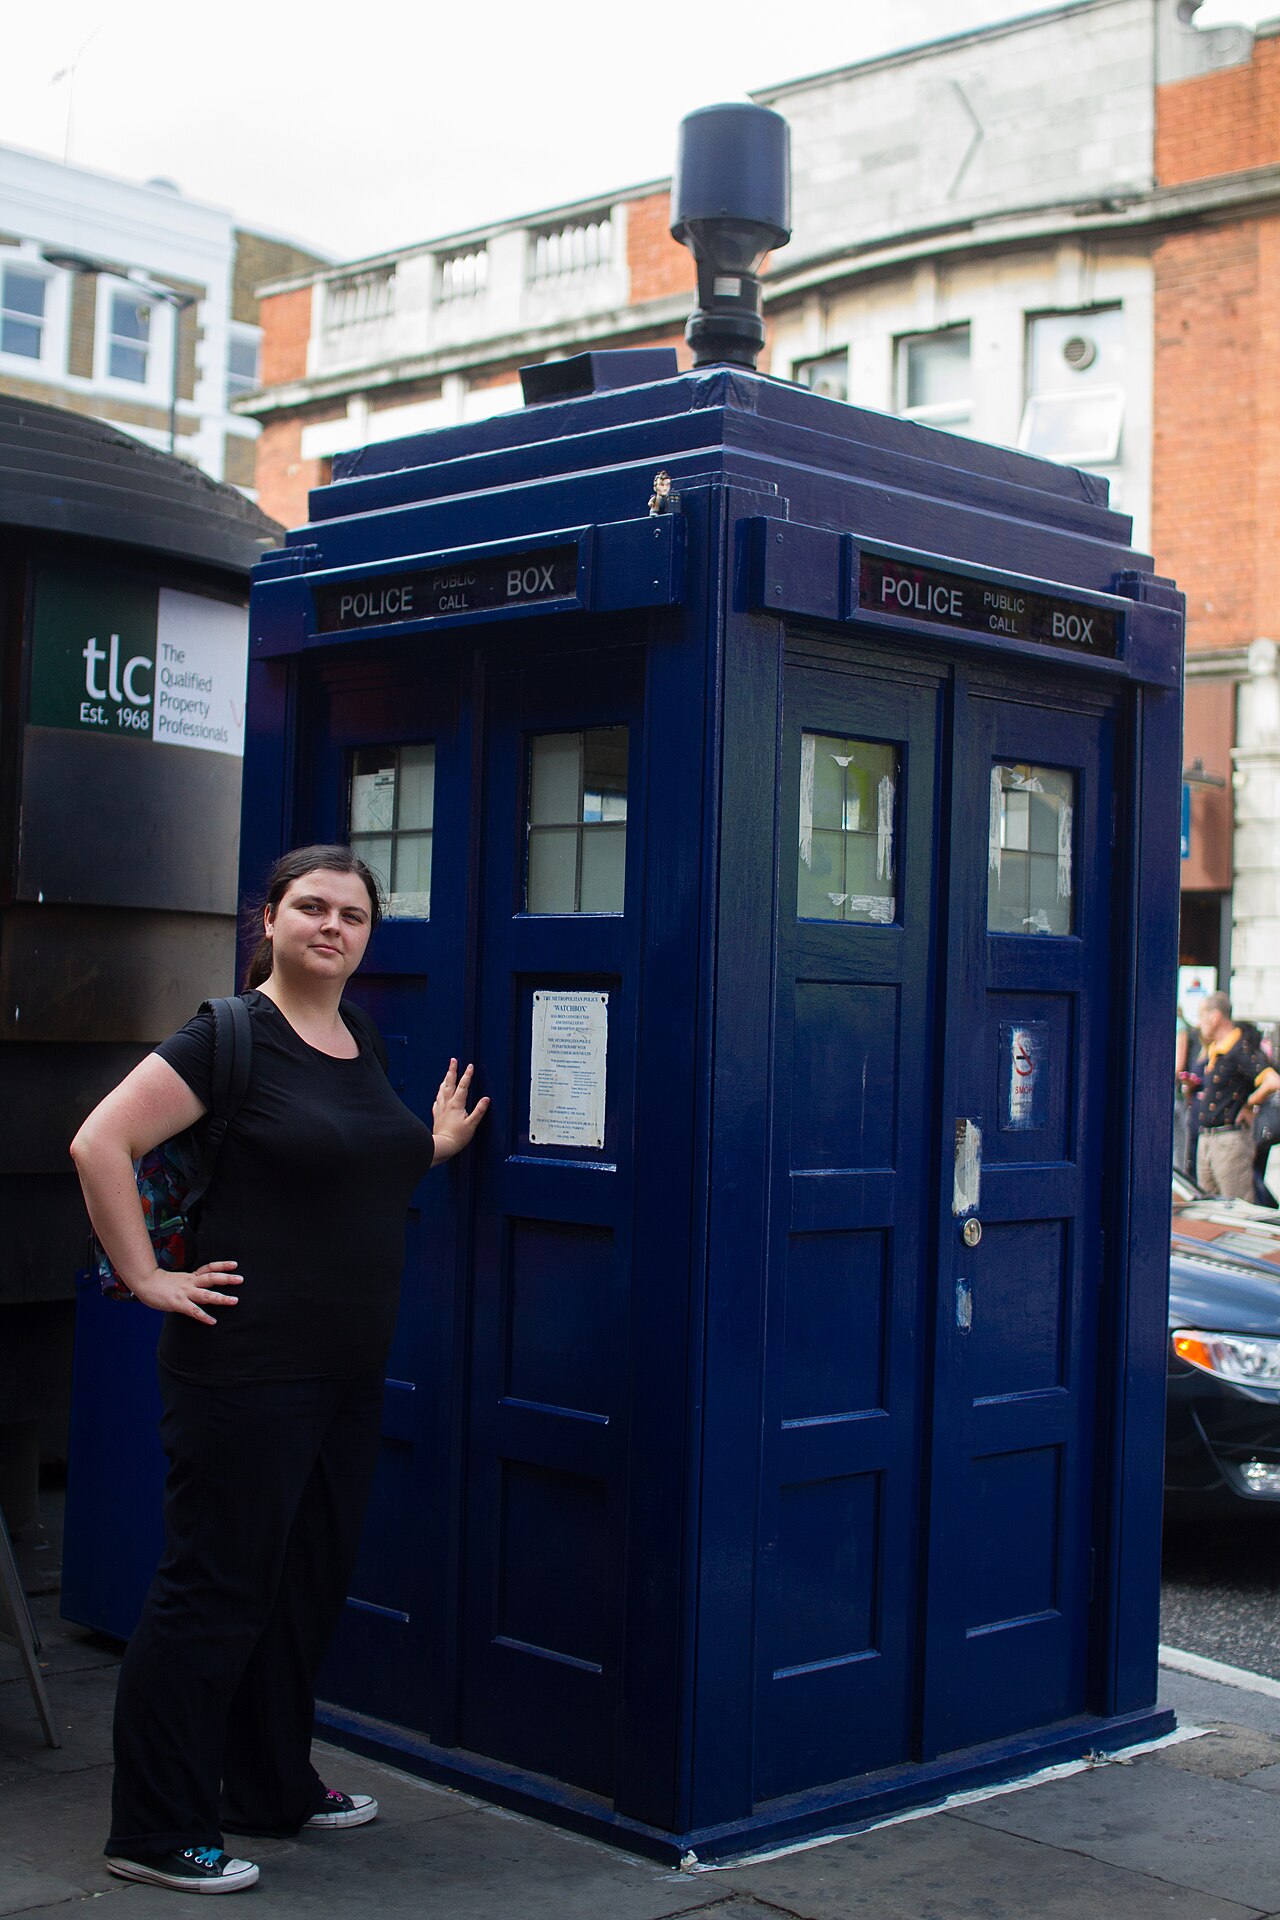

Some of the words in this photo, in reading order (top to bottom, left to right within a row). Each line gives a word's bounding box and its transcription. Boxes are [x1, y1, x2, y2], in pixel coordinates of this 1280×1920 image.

[433, 571, 476, 591] PUBLIC
[506, 564, 555, 596] BOX
[340, 586, 413, 620] POLICE
[438, 593, 469, 611] CALL
[881, 576, 963, 617] POLICE
[983, 591, 1025, 614] PUBLIC
[989, 614, 1018, 634] CALL
[1052, 612, 1094, 645] BOX
[161, 643, 186, 665] The
[82, 634, 153, 706] tlc
[160, 667, 213, 694] Qualified
[80, 702, 109, 725] Est.
[116, 707, 150, 731] 1968
[159, 691, 210, 720] Property
[158, 714, 229, 743] Professionals
